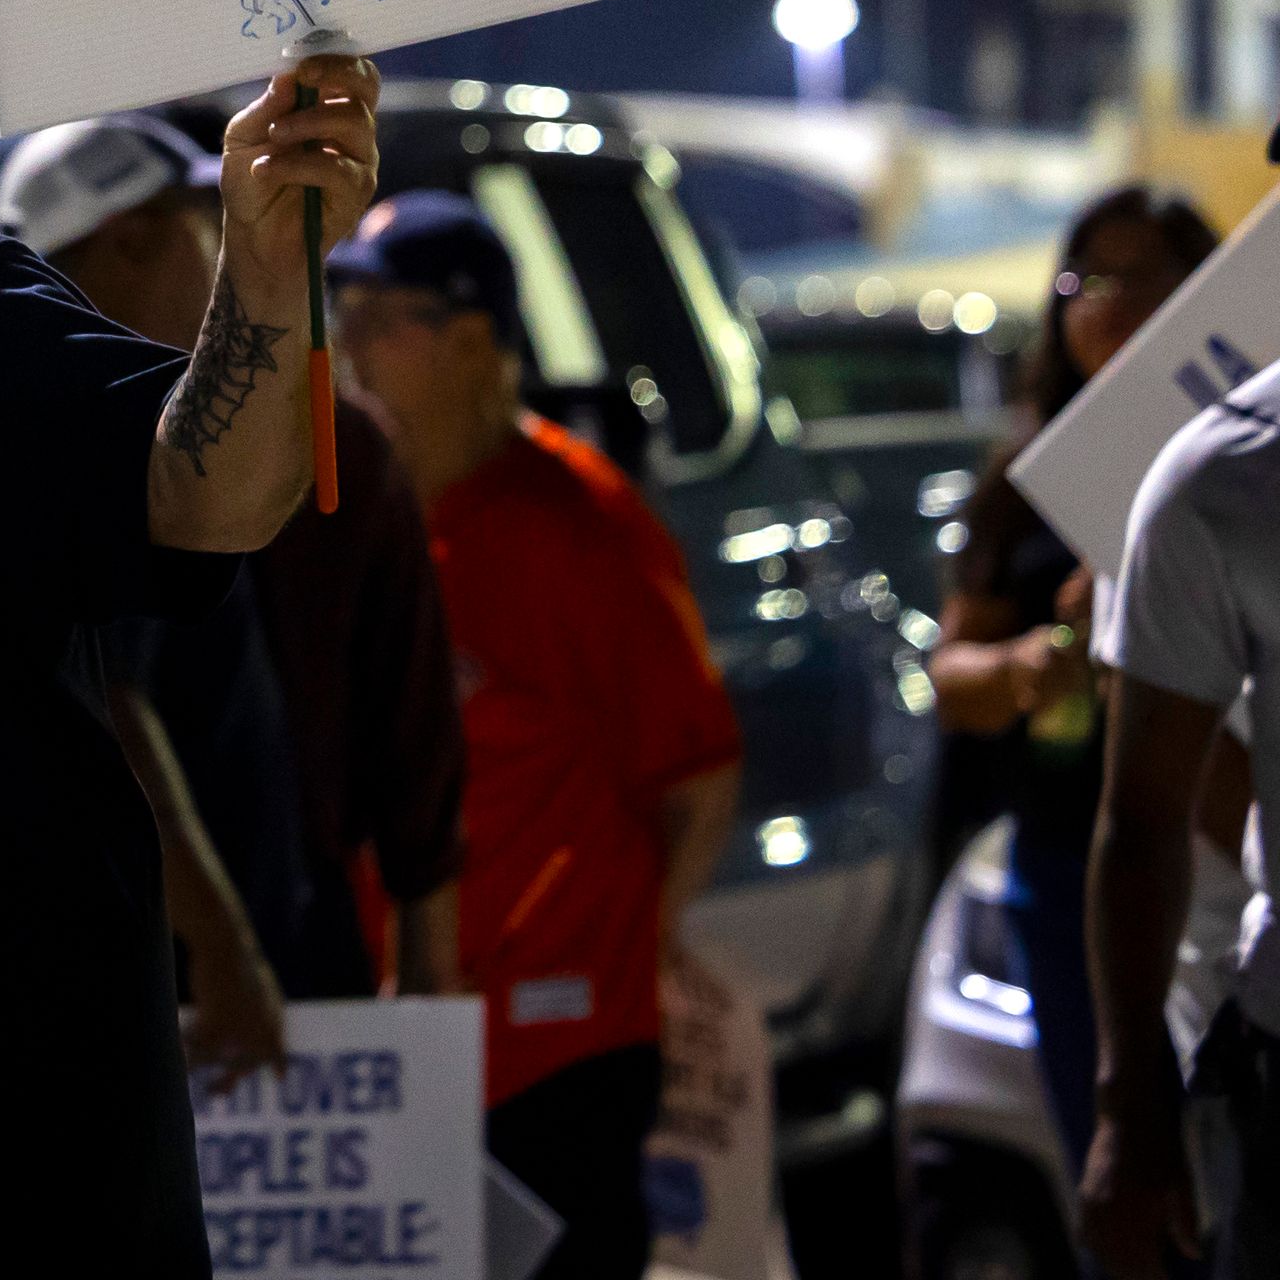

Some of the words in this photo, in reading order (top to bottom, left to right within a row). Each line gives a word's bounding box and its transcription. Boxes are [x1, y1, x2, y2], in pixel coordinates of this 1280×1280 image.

[278, 1050, 402, 1114] OVER
[197, 1130, 309, 1193] OPLE
[325, 1128, 367, 1190] IS
